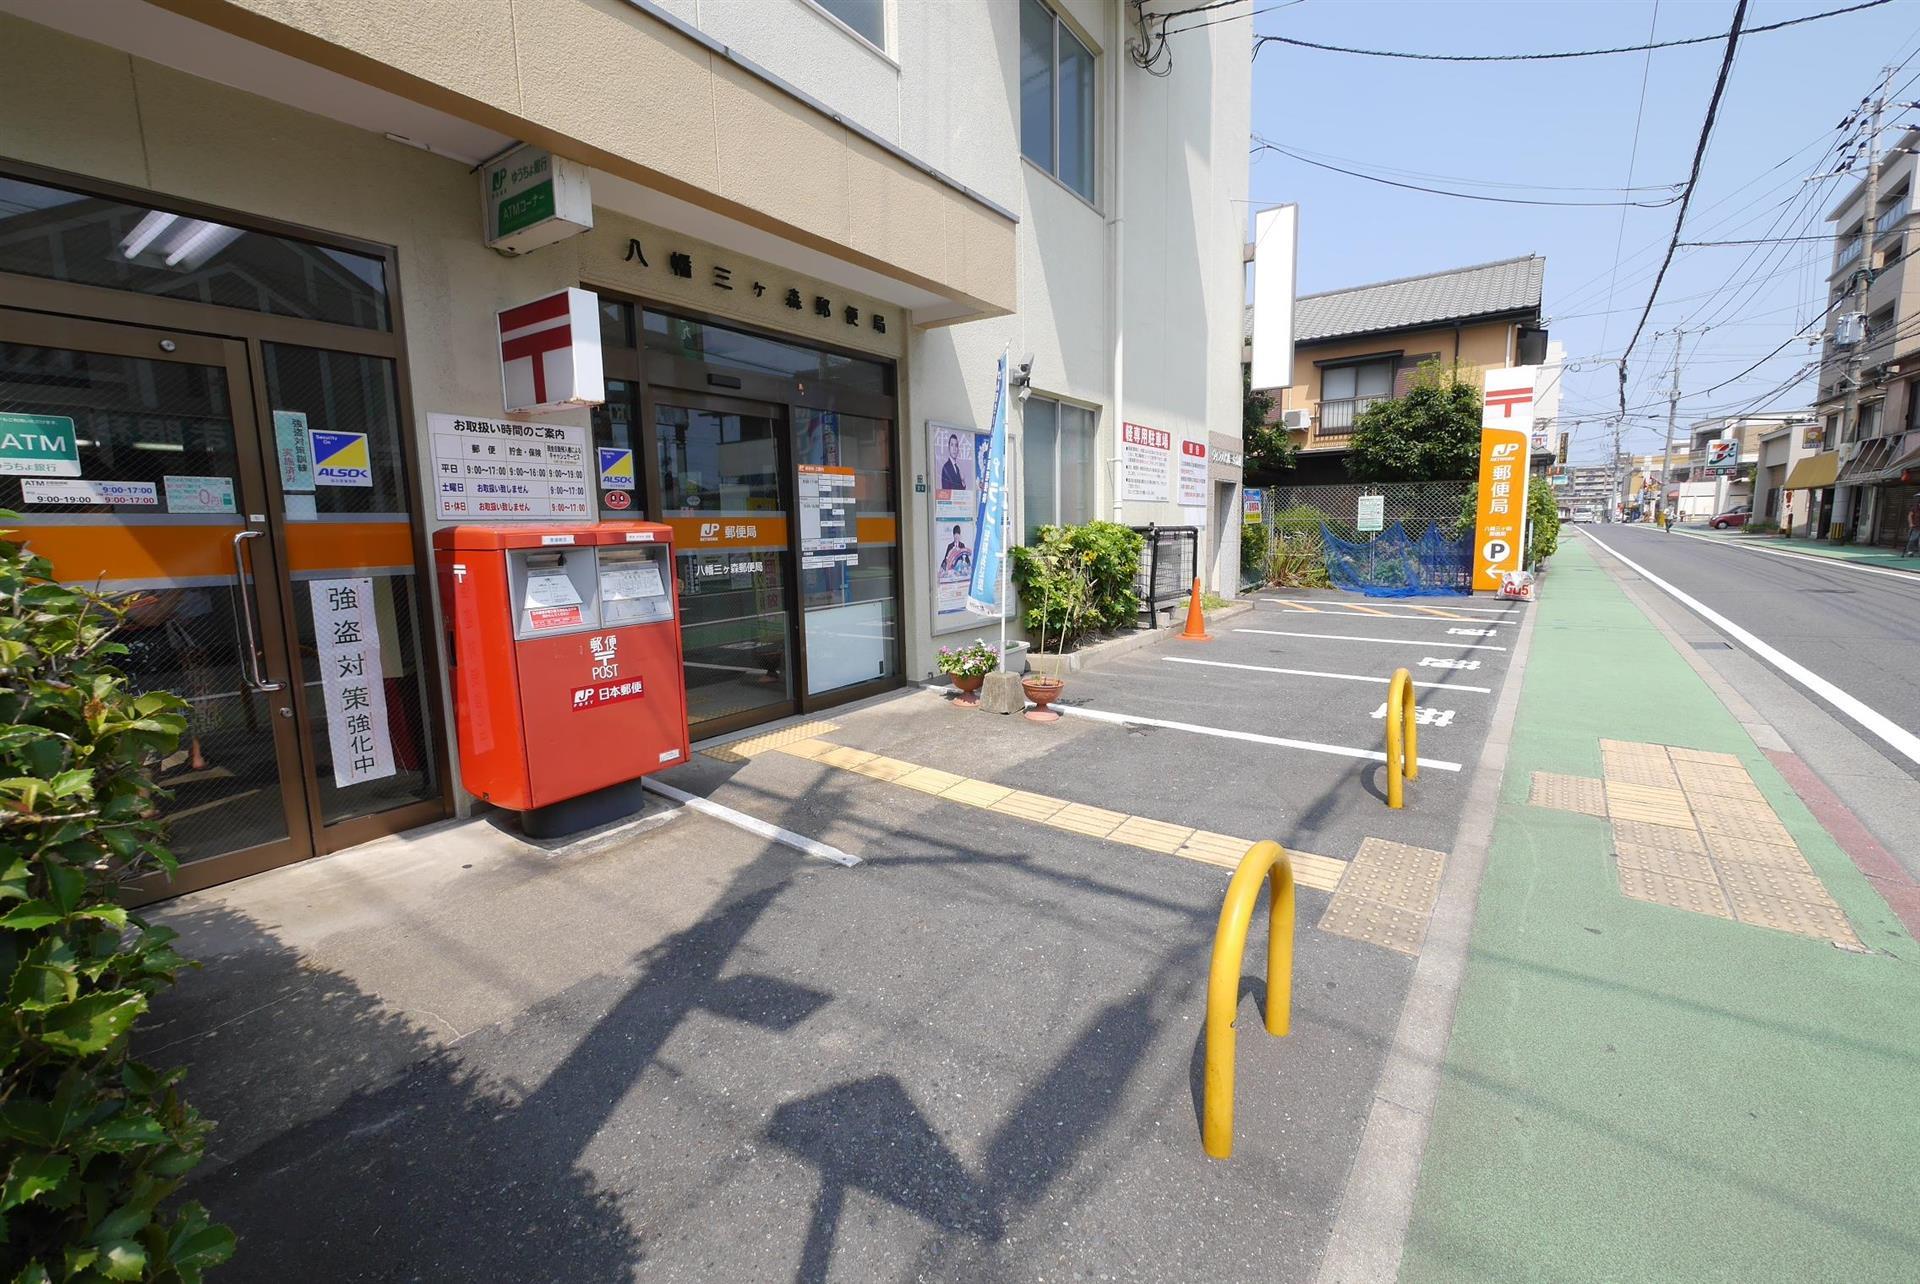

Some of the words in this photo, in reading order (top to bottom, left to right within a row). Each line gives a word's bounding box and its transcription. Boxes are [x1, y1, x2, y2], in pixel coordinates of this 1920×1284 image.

[512, 156, 547, 184] ゆうちょ銀行
[503, 195, 545, 219] ATMコーナー
[453, 419, 565, 440] お取扱い時間のご案内
[1, 433, 66, 452] ATM
[509, 446, 541, 458] 貯金・保険
[0, 463, 56, 473] うちょ銀行
[318, 468, 368, 478] ALSOK
[441, 463, 458, 474] 平日
[442, 482, 464, 492] 土曜日
[477, 484, 529, 494] お取扱い致しません
[603, 476, 631, 484] ALSOK
[1489, 465, 1511, 514] 郵便局
[444, 501, 466, 512] 日・休日
[479, 502, 530, 512] お取扱い致しません
[724, 525, 757, 539] 郵便局
[1491, 543, 1505, 559] P
[696, 561, 763, 576] 八幡三ヶ森郵便局
[590, 635, 617, 653] 郵便
[328, 586, 376, 774] 強盗対策強化中
[591, 664, 618, 680] POST
[599, 681, 642, 701] 日本郵便
